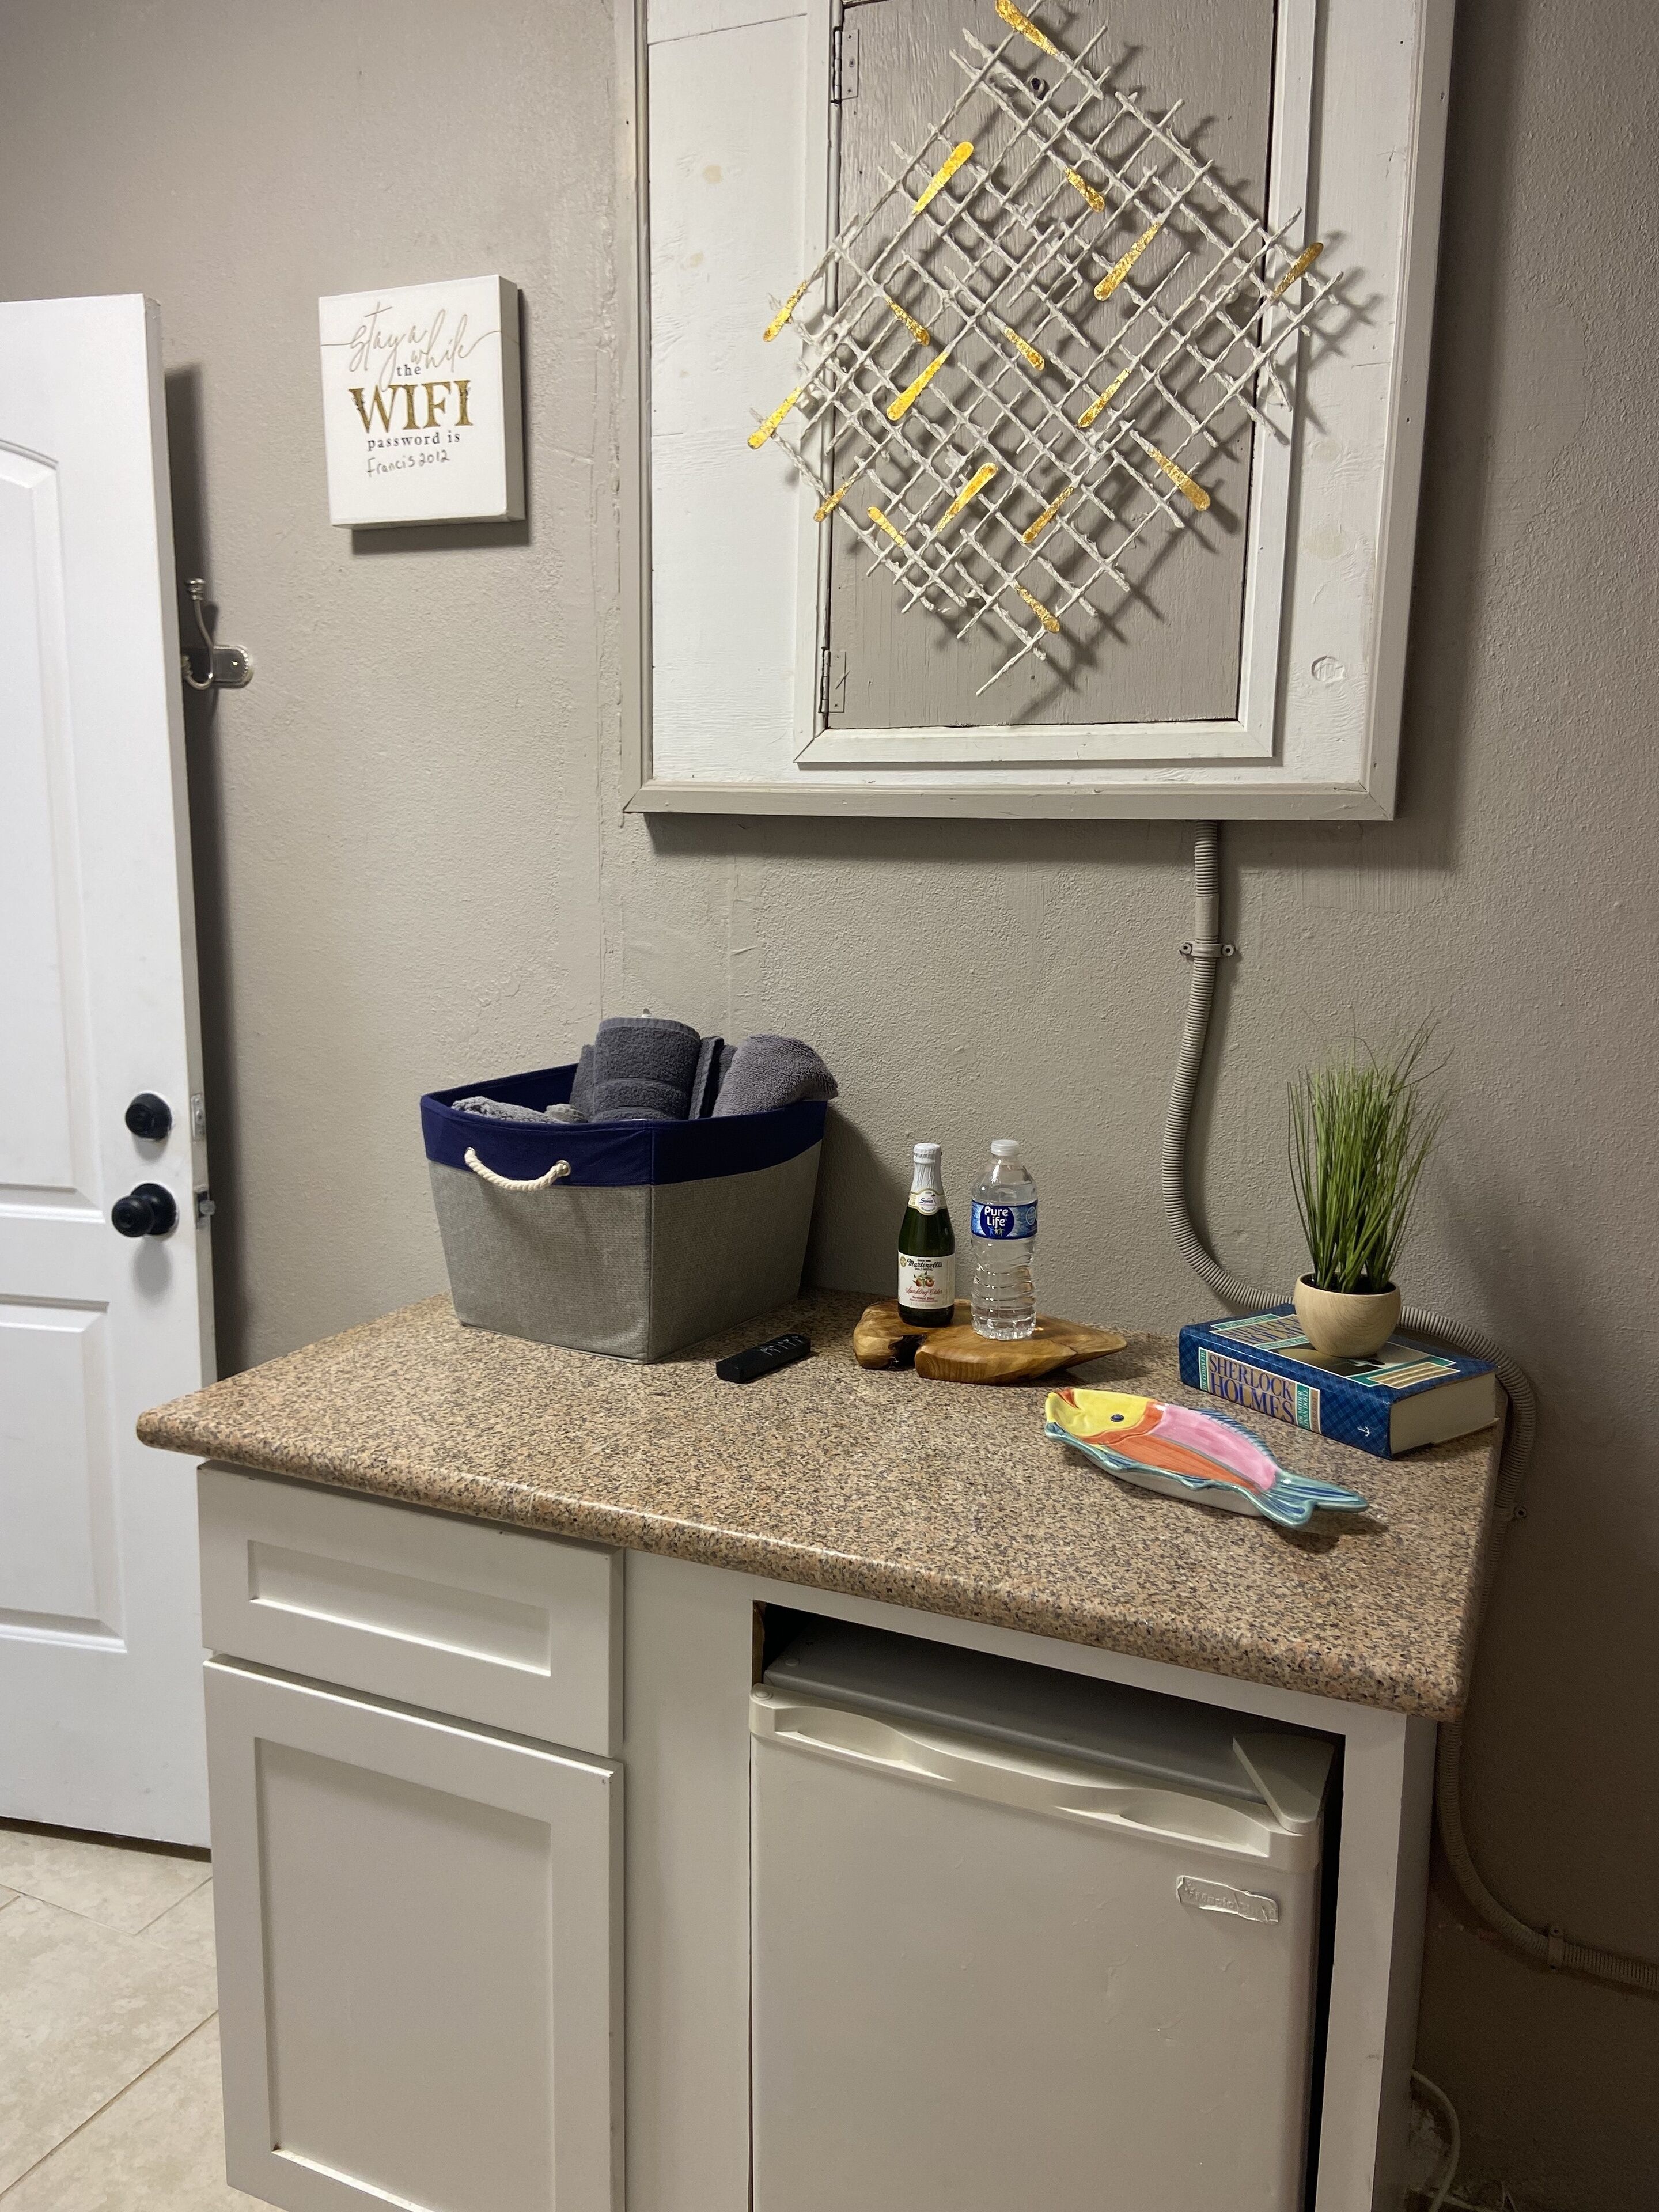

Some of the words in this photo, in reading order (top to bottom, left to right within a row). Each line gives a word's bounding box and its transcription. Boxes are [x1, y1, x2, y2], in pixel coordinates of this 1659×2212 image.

[348, 301, 406, 392] stay
[411, 309, 479, 373] while
[396, 364, 422, 376] the
[349, 380, 473, 434] WIFI
[368, 432, 440, 452] password
[447, 430, 461, 443] is
[984, 1206, 1009, 1217] Pure
[987, 1216, 1006, 1228] Life
[1209, 1354, 1294, 1402] SHERLOCK
[1210, 1372, 1295, 1425] HOLMES
